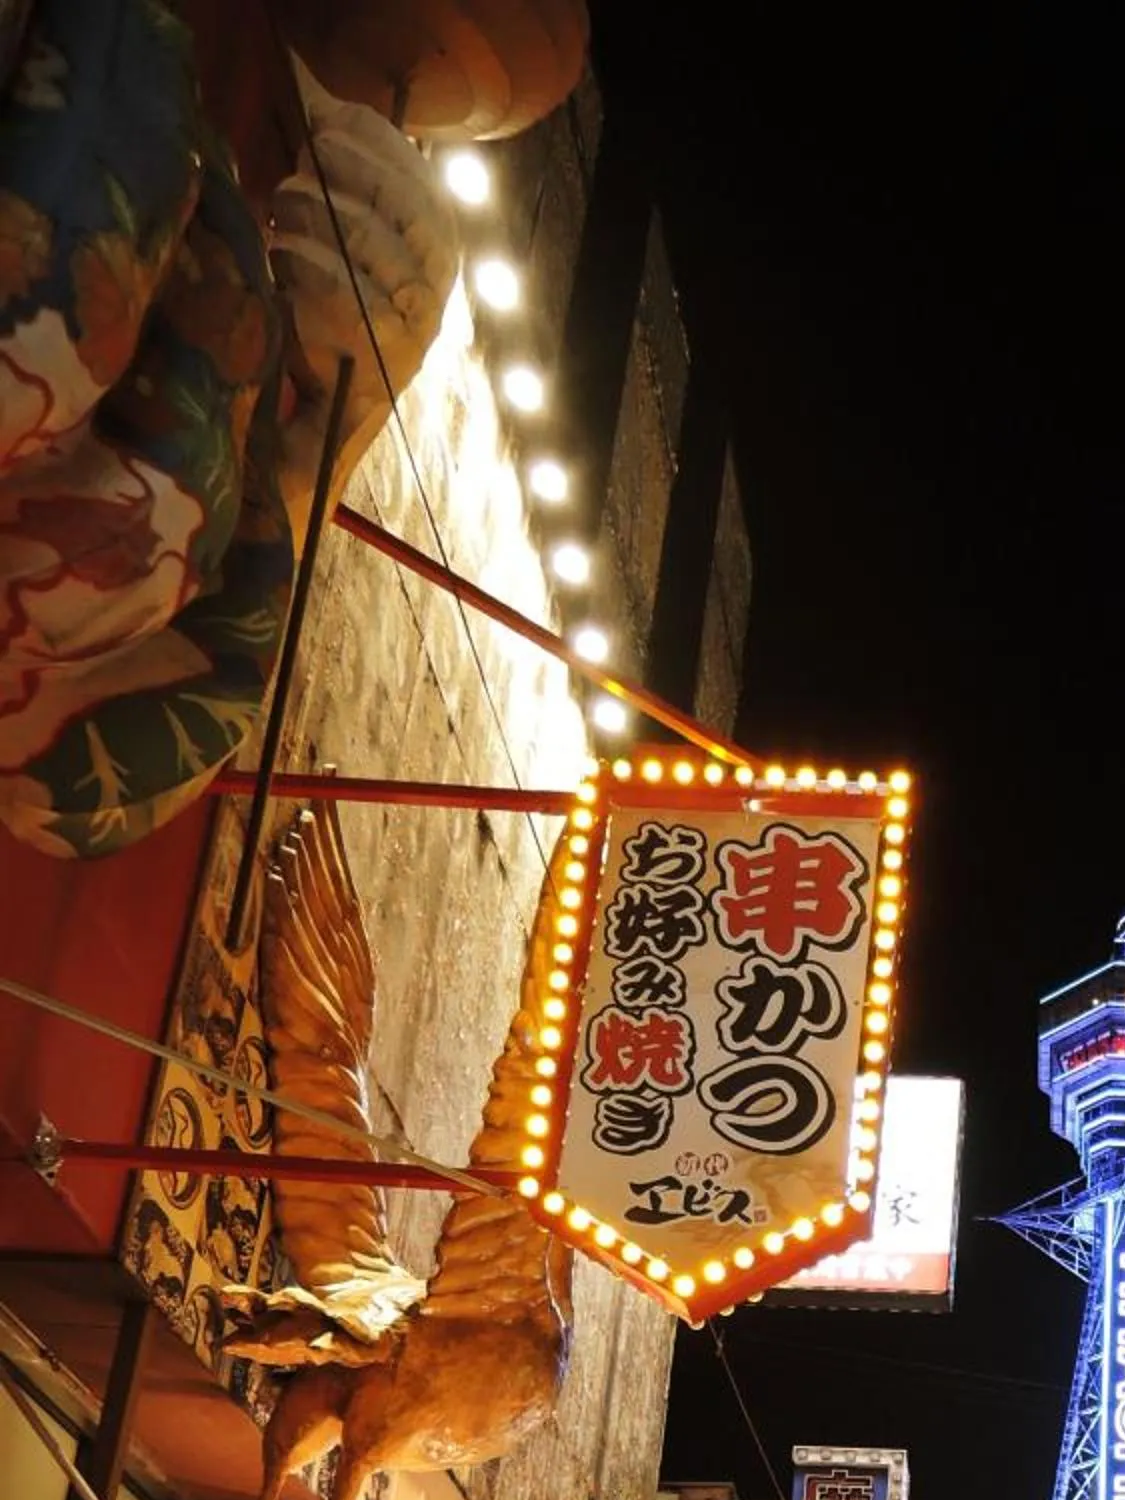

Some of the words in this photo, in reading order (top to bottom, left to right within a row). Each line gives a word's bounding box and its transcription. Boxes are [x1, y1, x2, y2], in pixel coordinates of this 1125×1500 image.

[580, 822, 706, 1155] お好み焼き
[697, 823, 867, 1155] 串かつ
